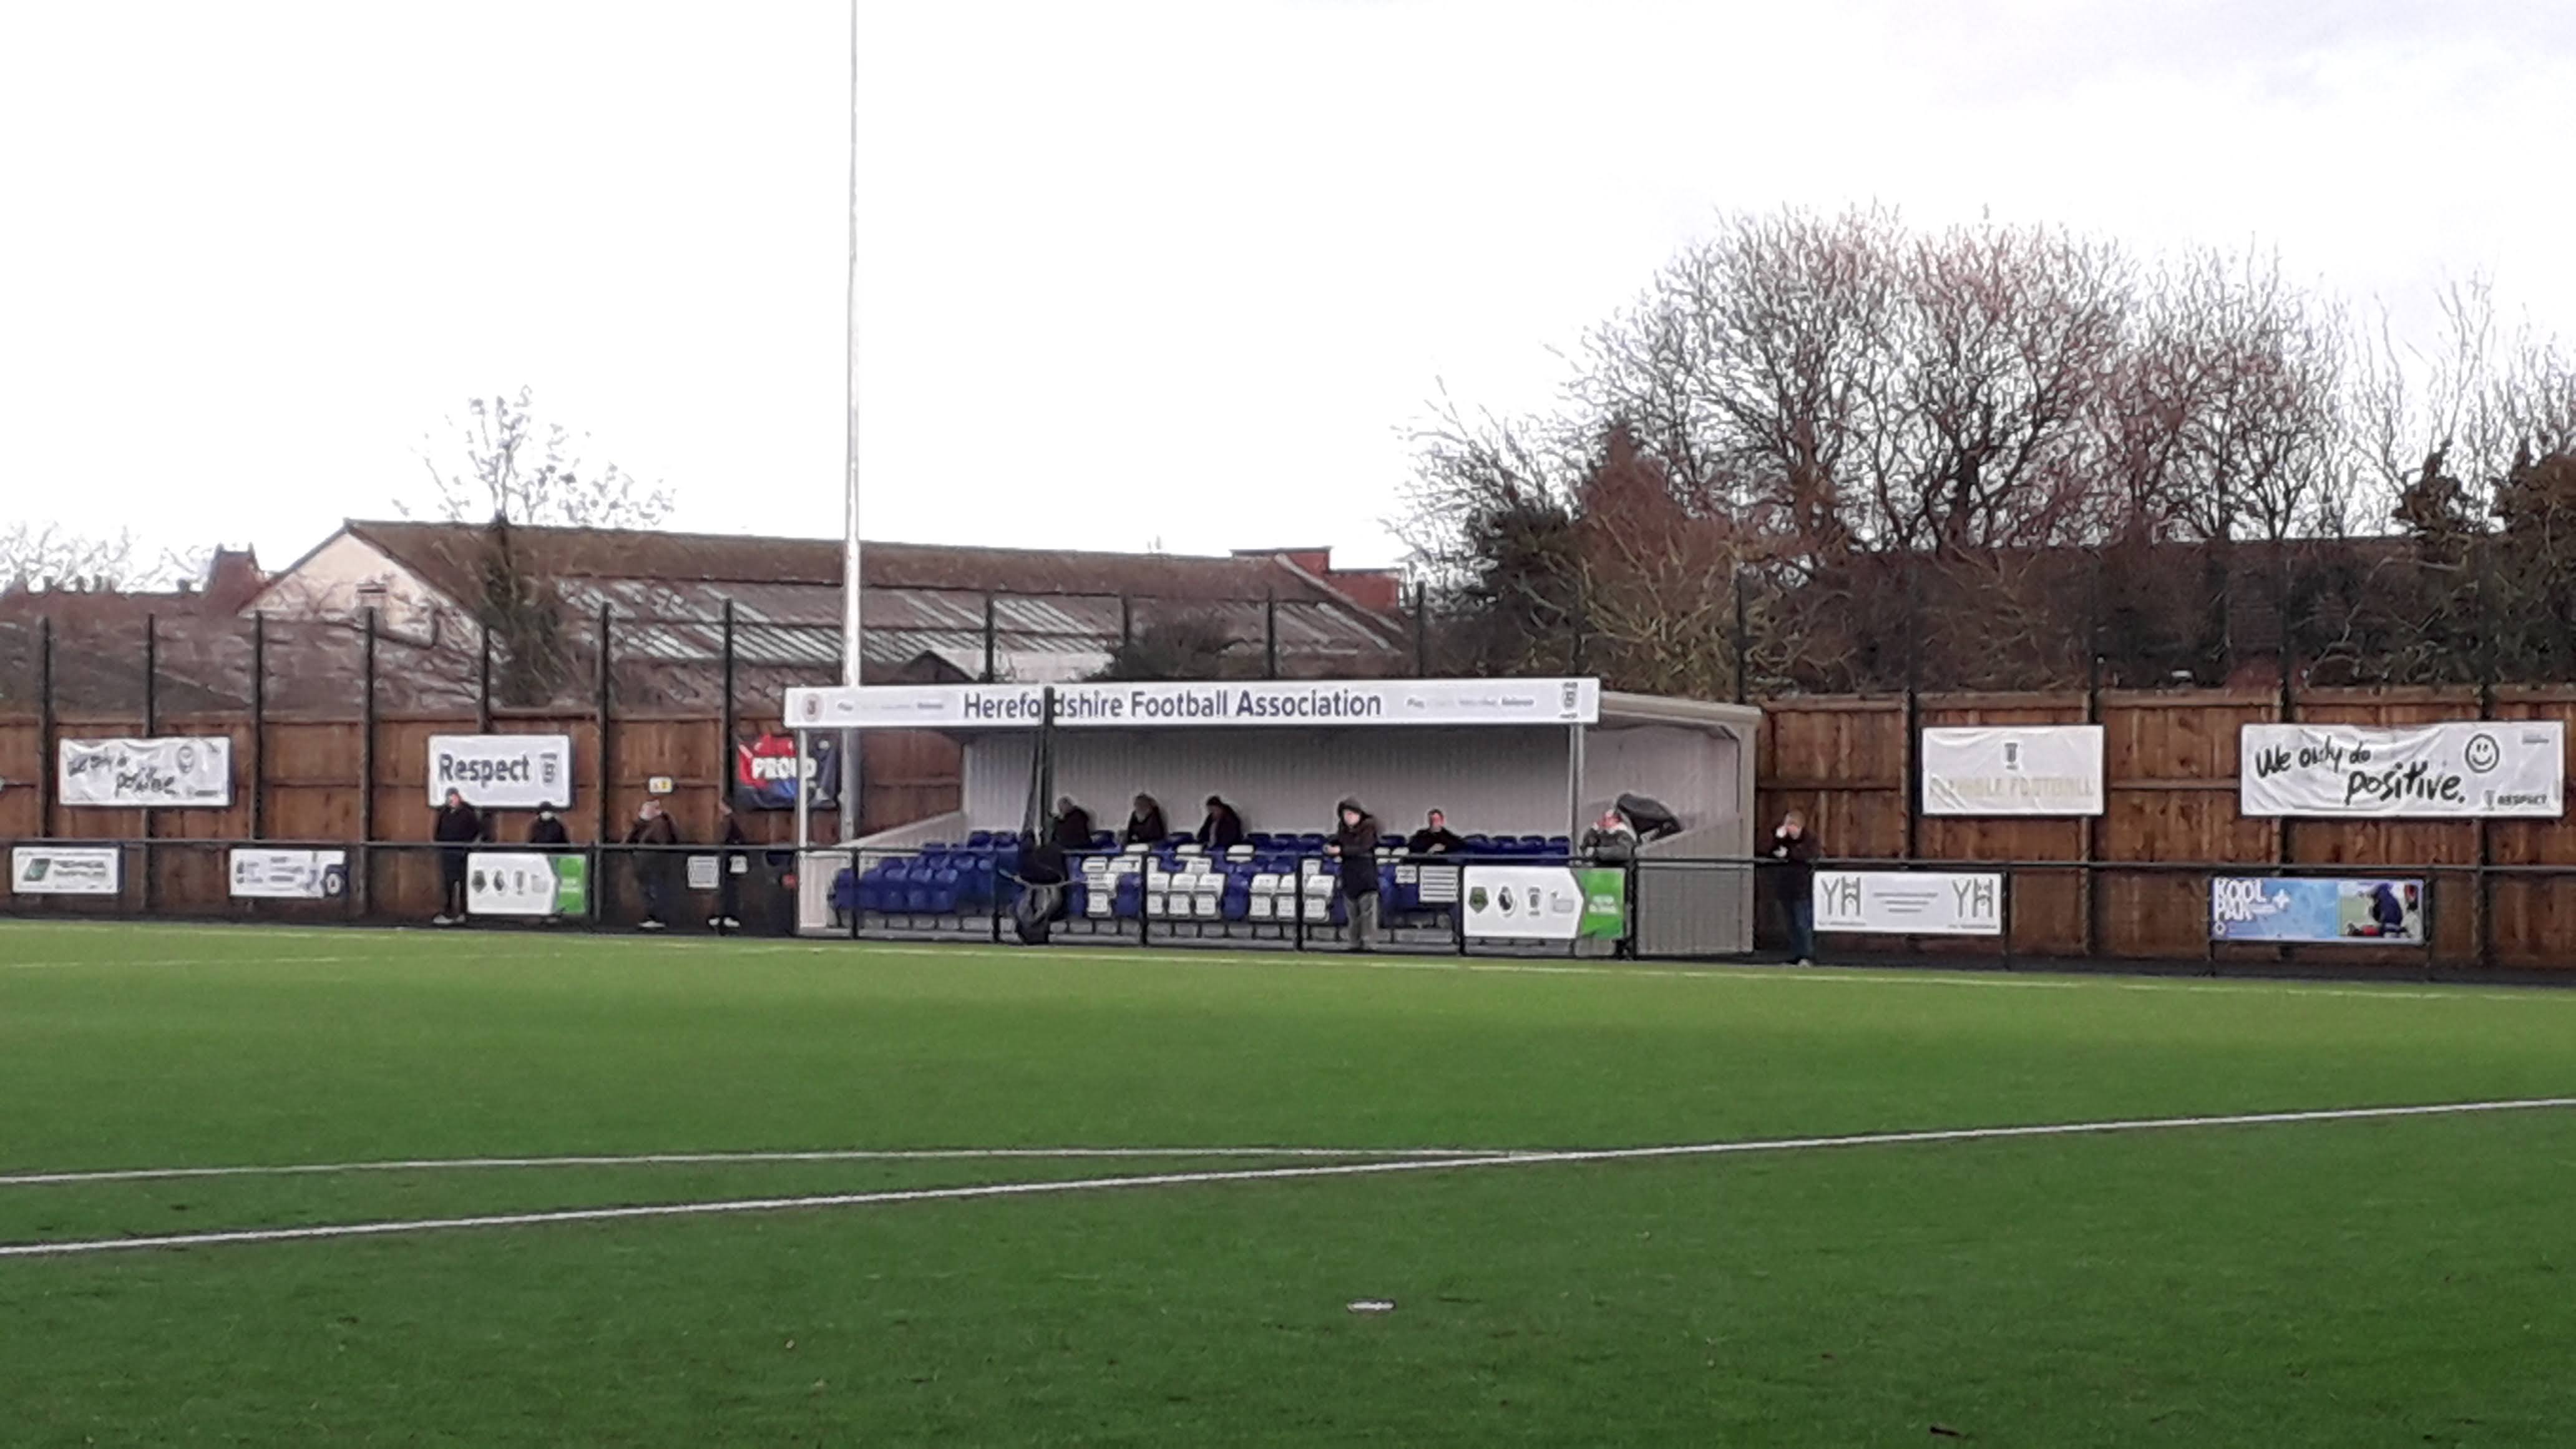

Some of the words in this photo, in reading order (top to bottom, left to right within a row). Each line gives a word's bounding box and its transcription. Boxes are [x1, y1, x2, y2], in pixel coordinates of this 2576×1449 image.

[964, 690, 1123, 719] Herefodshire
[1130, 689, 1227, 718] Football
[1236, 689, 1382, 717] Association
[439, 753, 529, 788] Respect
[2255, 744, 2291, 778] We
[2298, 734, 2343, 774] only
[2349, 740, 2371, 764] do
[2343, 760, 2466, 806] positive.
